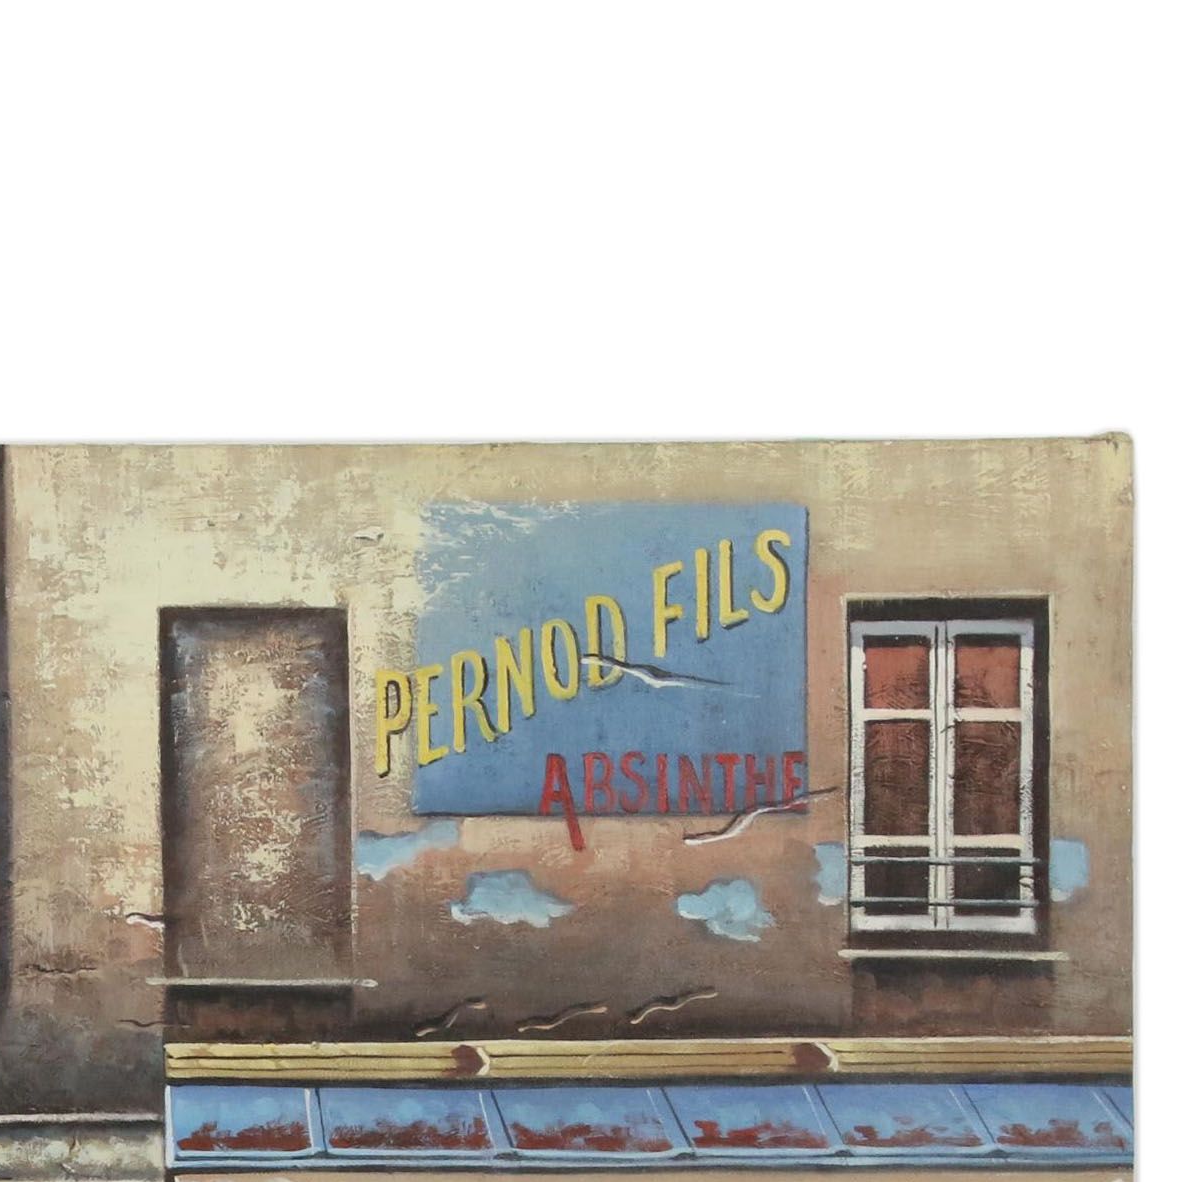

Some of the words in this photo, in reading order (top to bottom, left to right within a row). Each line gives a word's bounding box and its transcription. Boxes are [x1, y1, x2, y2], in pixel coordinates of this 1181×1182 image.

[375, 595, 627, 777] PERNOD
[653, 529, 791, 658] FILS
[539, 750, 808, 851] ABSINTHE
